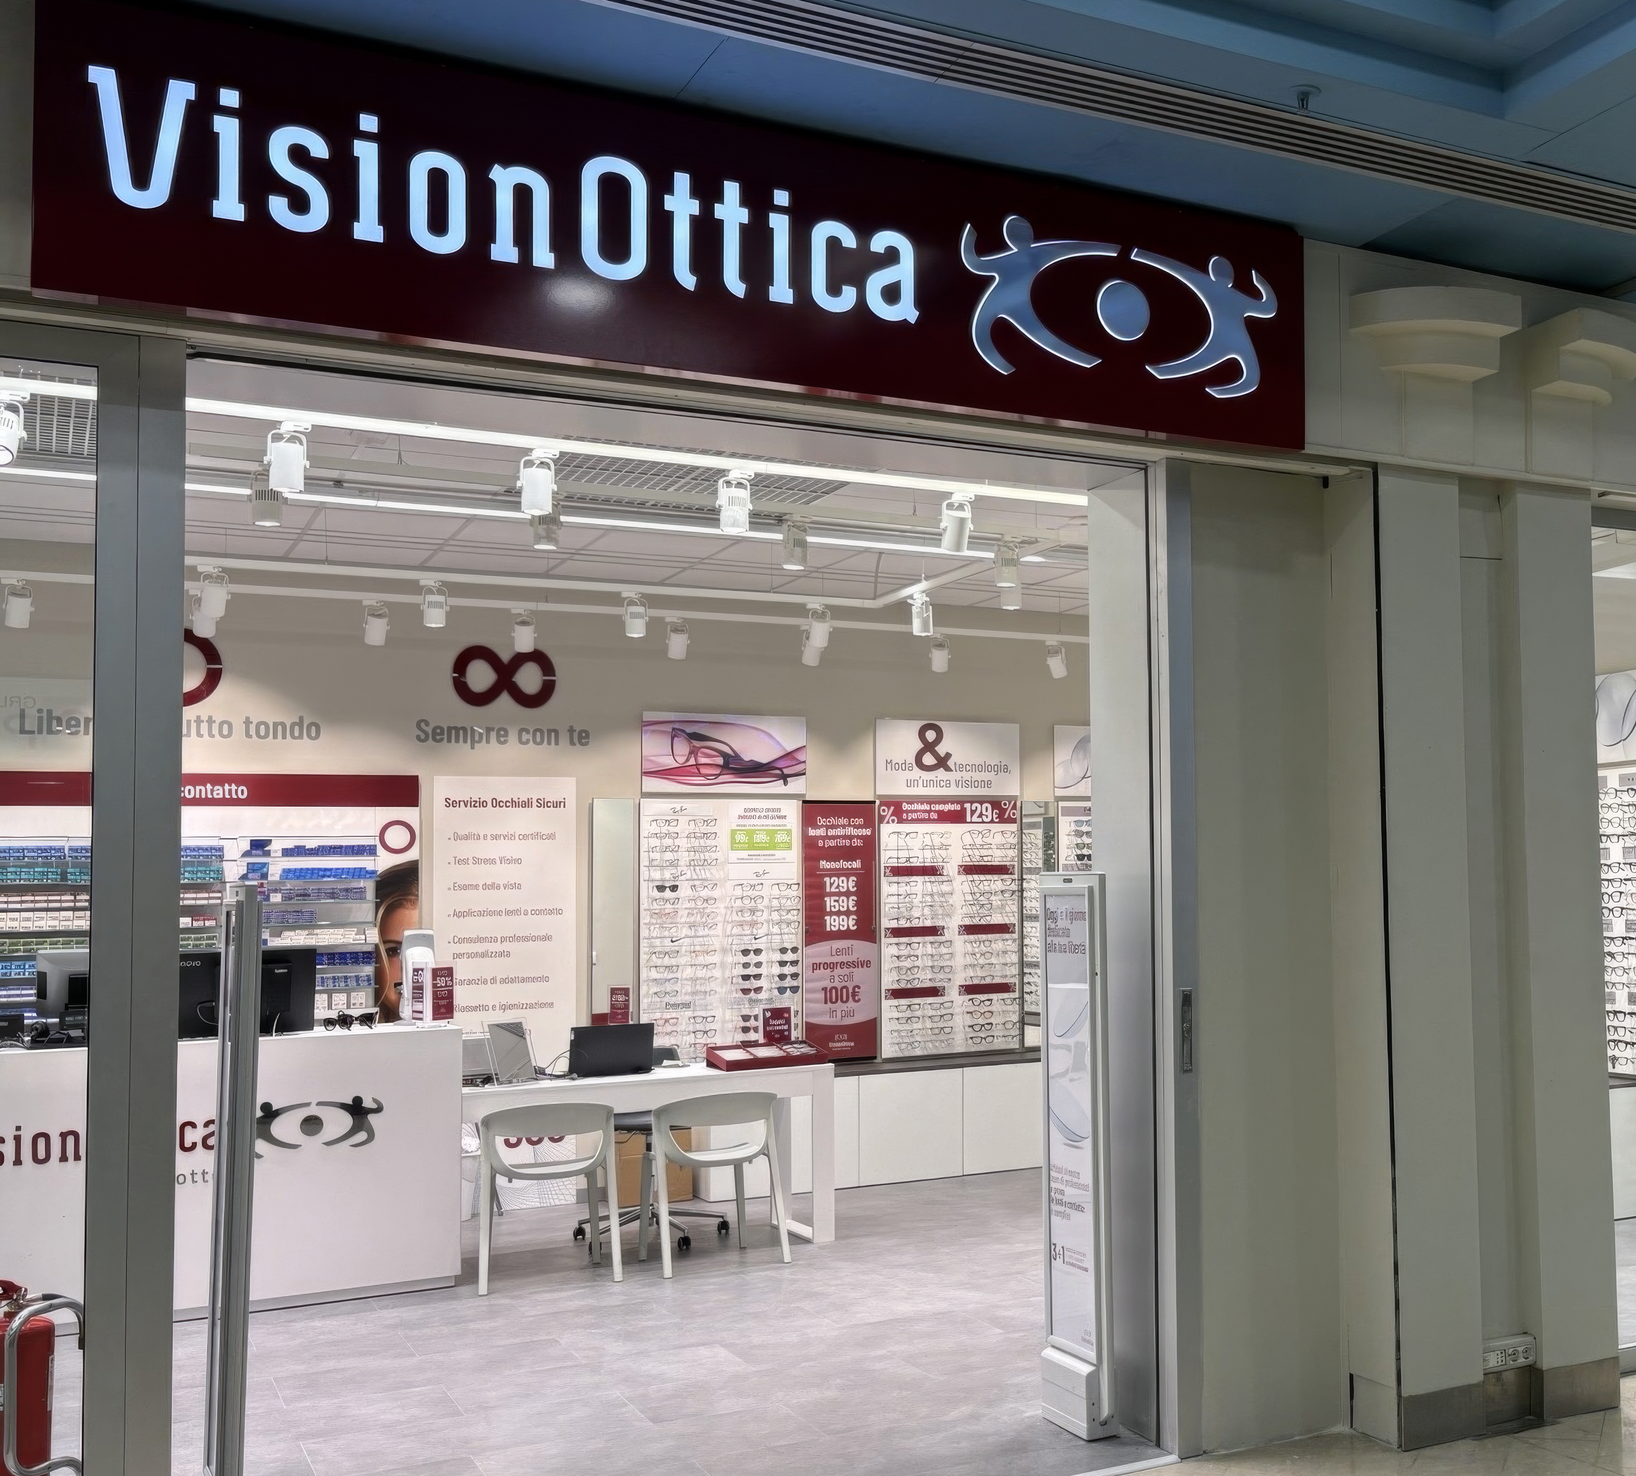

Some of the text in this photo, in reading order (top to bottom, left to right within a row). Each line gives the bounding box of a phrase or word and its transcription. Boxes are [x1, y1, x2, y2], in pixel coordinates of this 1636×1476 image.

[87, 65, 920, 325] VisionOttica
[243, 715, 322, 741] tondo
[415, 718, 591, 750] Sempre con te
[885, 722, 1012, 776] Moda & tecnologia,
[954, 776, 993, 789] visione
[444, 797, 567, 809] Servizio Occhiali Sicuri
[963, 803, 1000, 823] 129€
[452, 856, 470, 866] Test
[502, 881, 522, 890] vista
[824, 876, 857, 892] 129€
[824, 896, 857, 912] 159€
[824, 915, 858, 931] 199€
[830, 944, 854, 957] Lenti
[811, 958, 872, 974] progressive
[489, 976, 498, 985] di
[829, 972, 854, 983] a soli
[821, 985, 862, 1005] 100€
[841, 1007, 855, 1021] più
